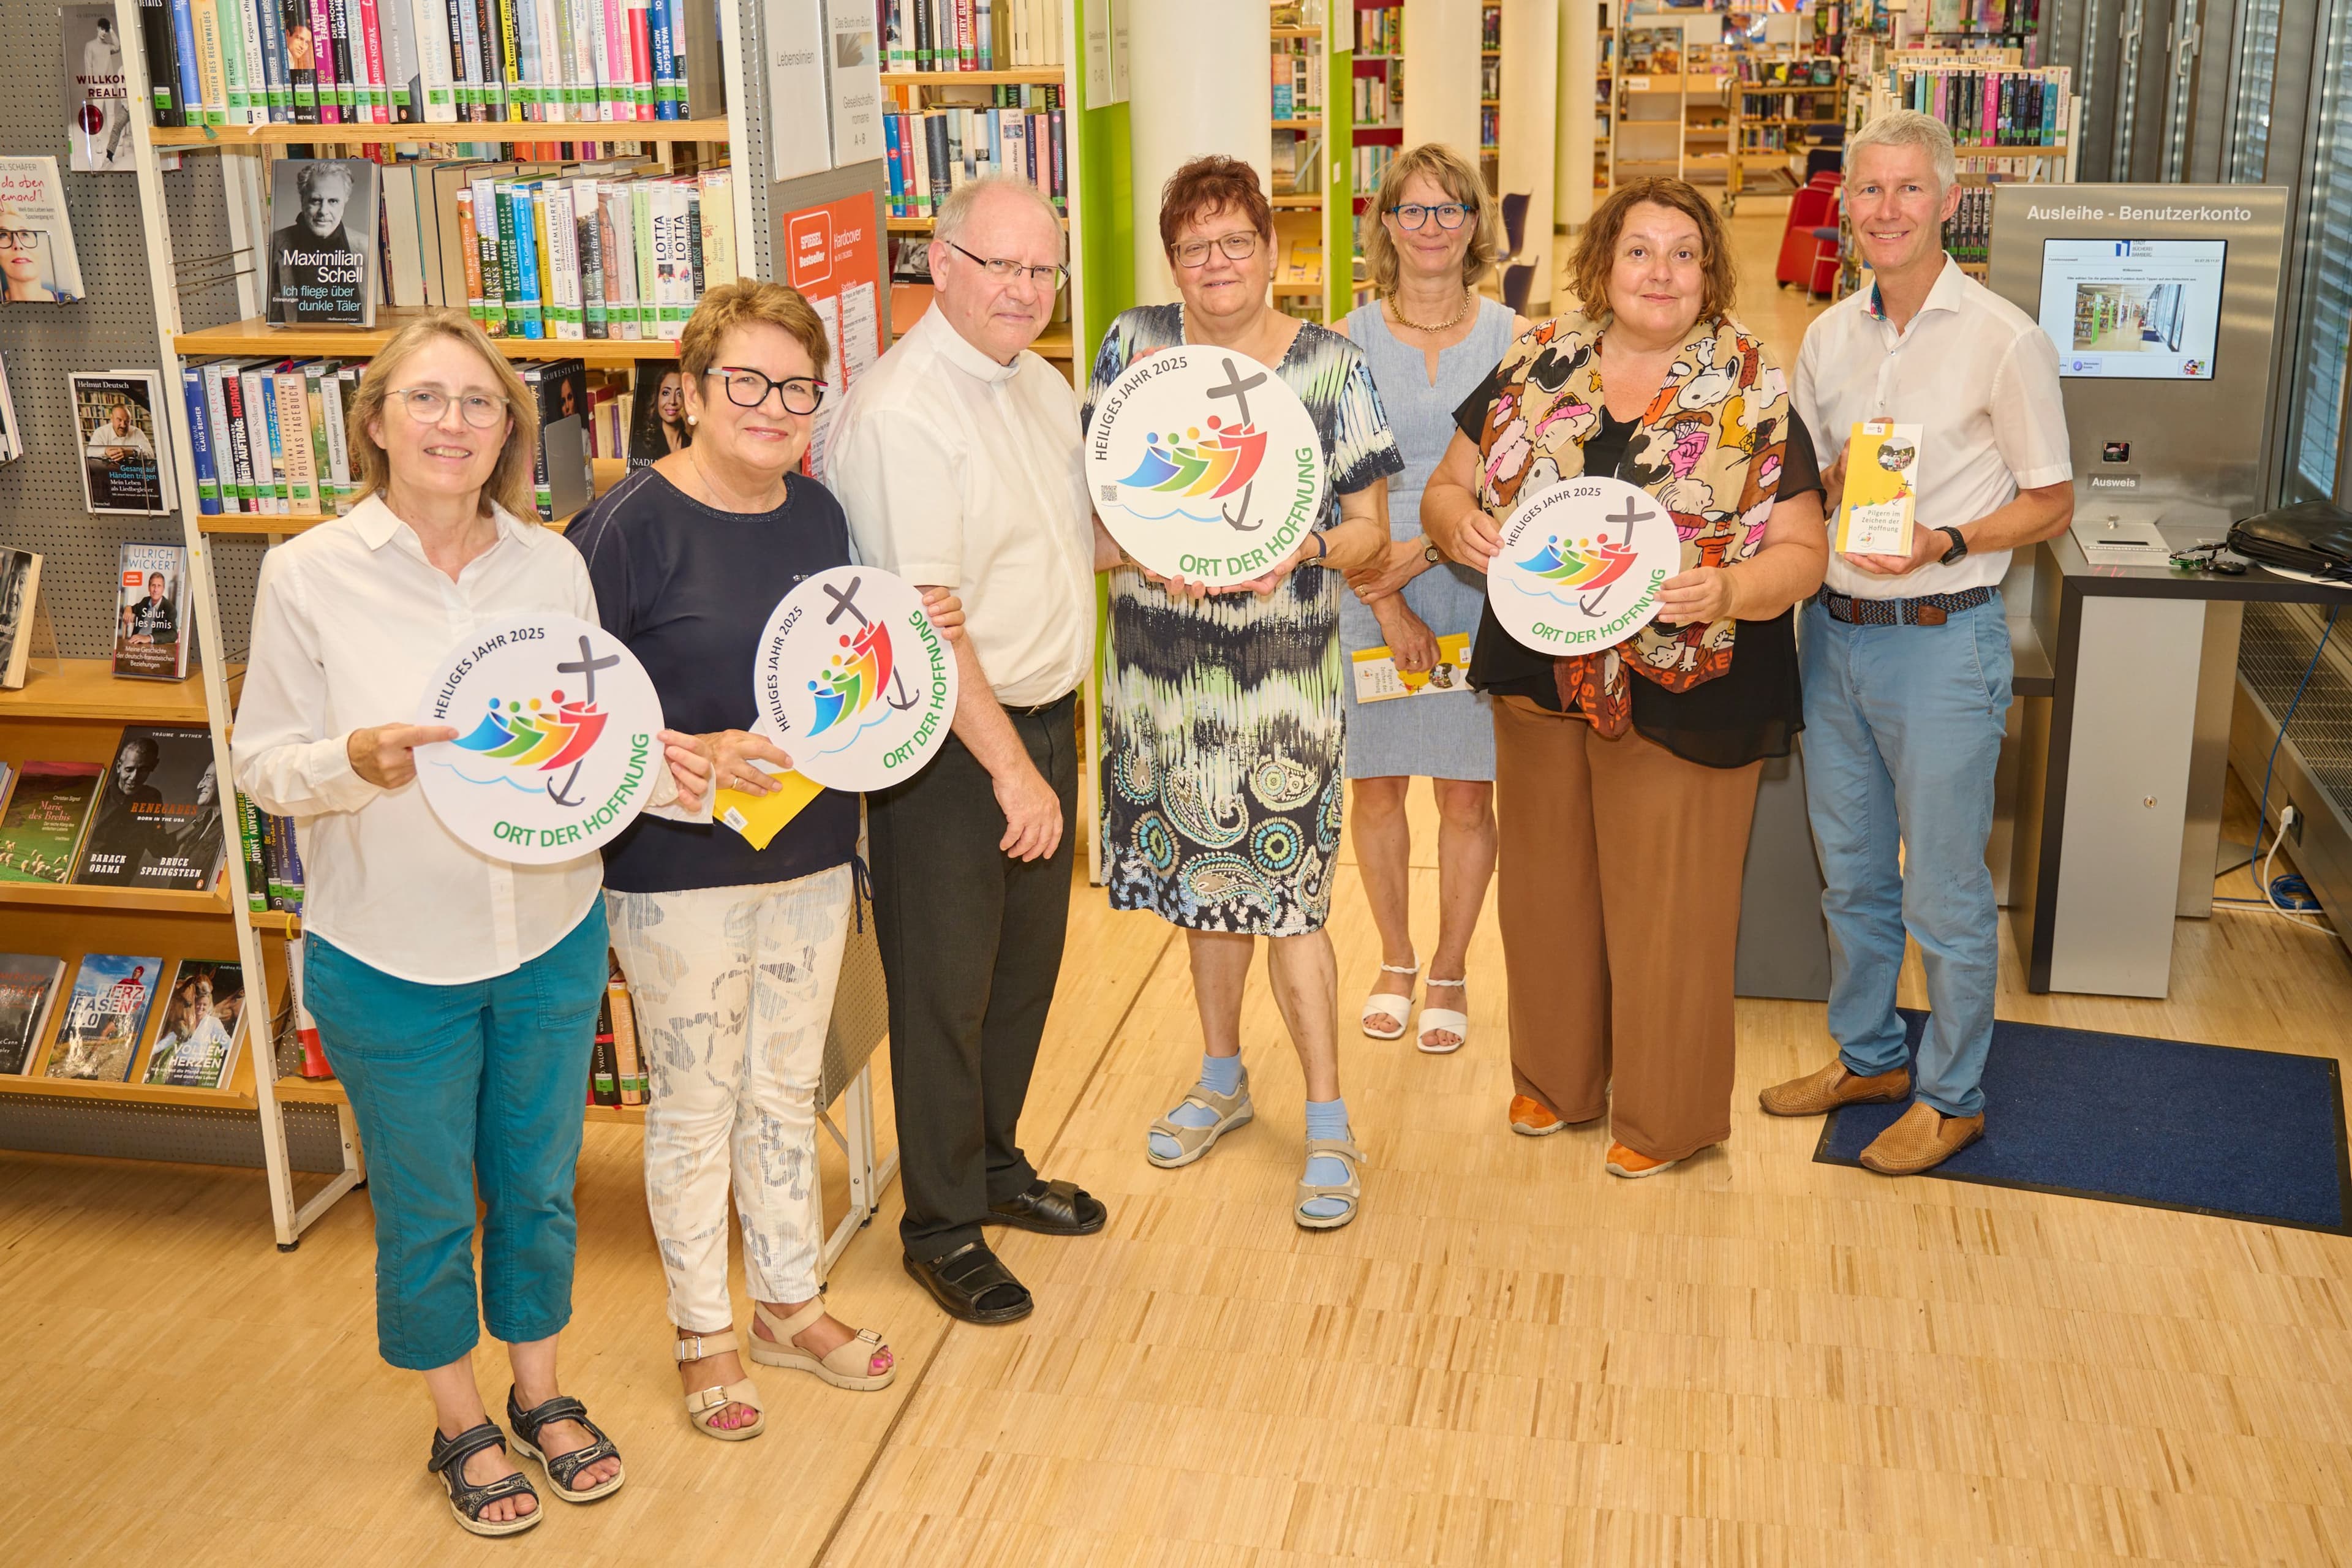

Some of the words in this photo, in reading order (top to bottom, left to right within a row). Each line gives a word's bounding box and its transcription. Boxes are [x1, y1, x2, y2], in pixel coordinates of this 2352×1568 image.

[315, 34, 323, 58] ALTE
[506, 24, 515, 67] Komplett
[776, 50, 815, 67] Lebenslinien
[843, 93, 875, 109] Gesellschafts-
[852, 113, 870, 125] romane
[854, 134, 859, 146] A
[862, 132, 866, 145] B
[1, 175, 14, 187] da
[18, 174, 45, 188] oben
[2027, 206, 2103, 221] Ausleihe
[2119, 206, 2251, 221] Benutzerkonto
[589, 213, 597, 236] Afrika
[654, 216, 666, 261] LOTTA
[674, 215, 686, 260] LOTTA
[800, 232, 823, 249] SPIEGEL
[834, 228, 861, 249] Hardcover
[284, 249, 363, 266] Maximilian
[467, 257, 472, 266] zu
[509, 239, 518, 273] SCHÄFER
[592, 251, 600, 268] Herz
[799, 251, 825, 268] Bestseller
[317, 266, 363, 283] Schell
[467, 269, 475, 286] Dich
[283, 285, 298, 296] Ich
[301, 285, 328, 299] fliege
[331, 285, 354, 296] über
[299, 300, 333, 311] dunkle
[337, 300, 361, 311] Täler
[543, 367, 571, 382] SCHWESTA
[288, 385, 303, 432] TAGEBUCH
[1096, 397, 1122, 461] HEILIGES
[1118, 369, 1152, 399] JAHR
[1153, 356, 1188, 375] 2025
[195, 406, 203, 430] BEIMER
[230, 424, 240, 462] Schabirosky
[287, 448, 296, 477] POLINA
[295, 437, 309, 477] POLINAS
[2092, 478, 2135, 488] Ausweis
[1180, 554, 1222, 576] ORT
[1227, 548, 1268, 576] DER
[1265, 447, 1315, 556] HOFFNUNG
[1507, 505, 1542, 546] HEILIGES
[1543, 491, 1570, 508] JAHR
[1574, 488, 1601, 496] 2025
[1868, 524, 1899, 533] Hoffnung
[134, 548, 173, 560] ULRICH
[129, 559, 177, 571] WICKERT
[141, 608, 165, 619] Salut
[1532, 622, 1563, 642] ORT
[1564, 630, 1596, 644] DER
[1600, 569, 1665, 638] HOFFNUNG
[135, 616, 148, 628] les
[151, 619, 172, 630] amis
[780, 606, 802, 635] 2025
[141, 646, 167, 655] Geschichte
[768, 636, 784, 671] JAHR
[130, 660, 160, 669] Beziehungen
[909, 610, 946, 709] HOFFNUNG
[434, 658, 472, 719] HEILIGES
[472, 635, 507, 662] JAHR
[511, 628, 545, 642] 2025
[768, 674, 790, 732] HEILIGES
[913, 712, 940, 746] DER
[883, 740, 915, 768] ORT
[494, 821, 535, 846] ORT
[541, 824, 581, 847] DER
[582, 733, 649, 835] HOFFNUNG
[39, 800, 63, 811] Marie
[131, 802, 200, 816] RENEGADES
[28, 809, 42, 820] des
[45, 809, 71, 822] Brebis
[90, 853, 127, 864] BARACK
[243, 839, 252, 862] HELGE
[89, 864, 121, 875] OBAMA
[160, 857, 190, 867] BRUCE
[140, 865, 203, 878] SPRINGSTEEN
[173, 1042, 226, 1057] VOLLEM
[627, 1046, 635, 1060] Ich
[168, 1055, 223, 1069] HERZEN
